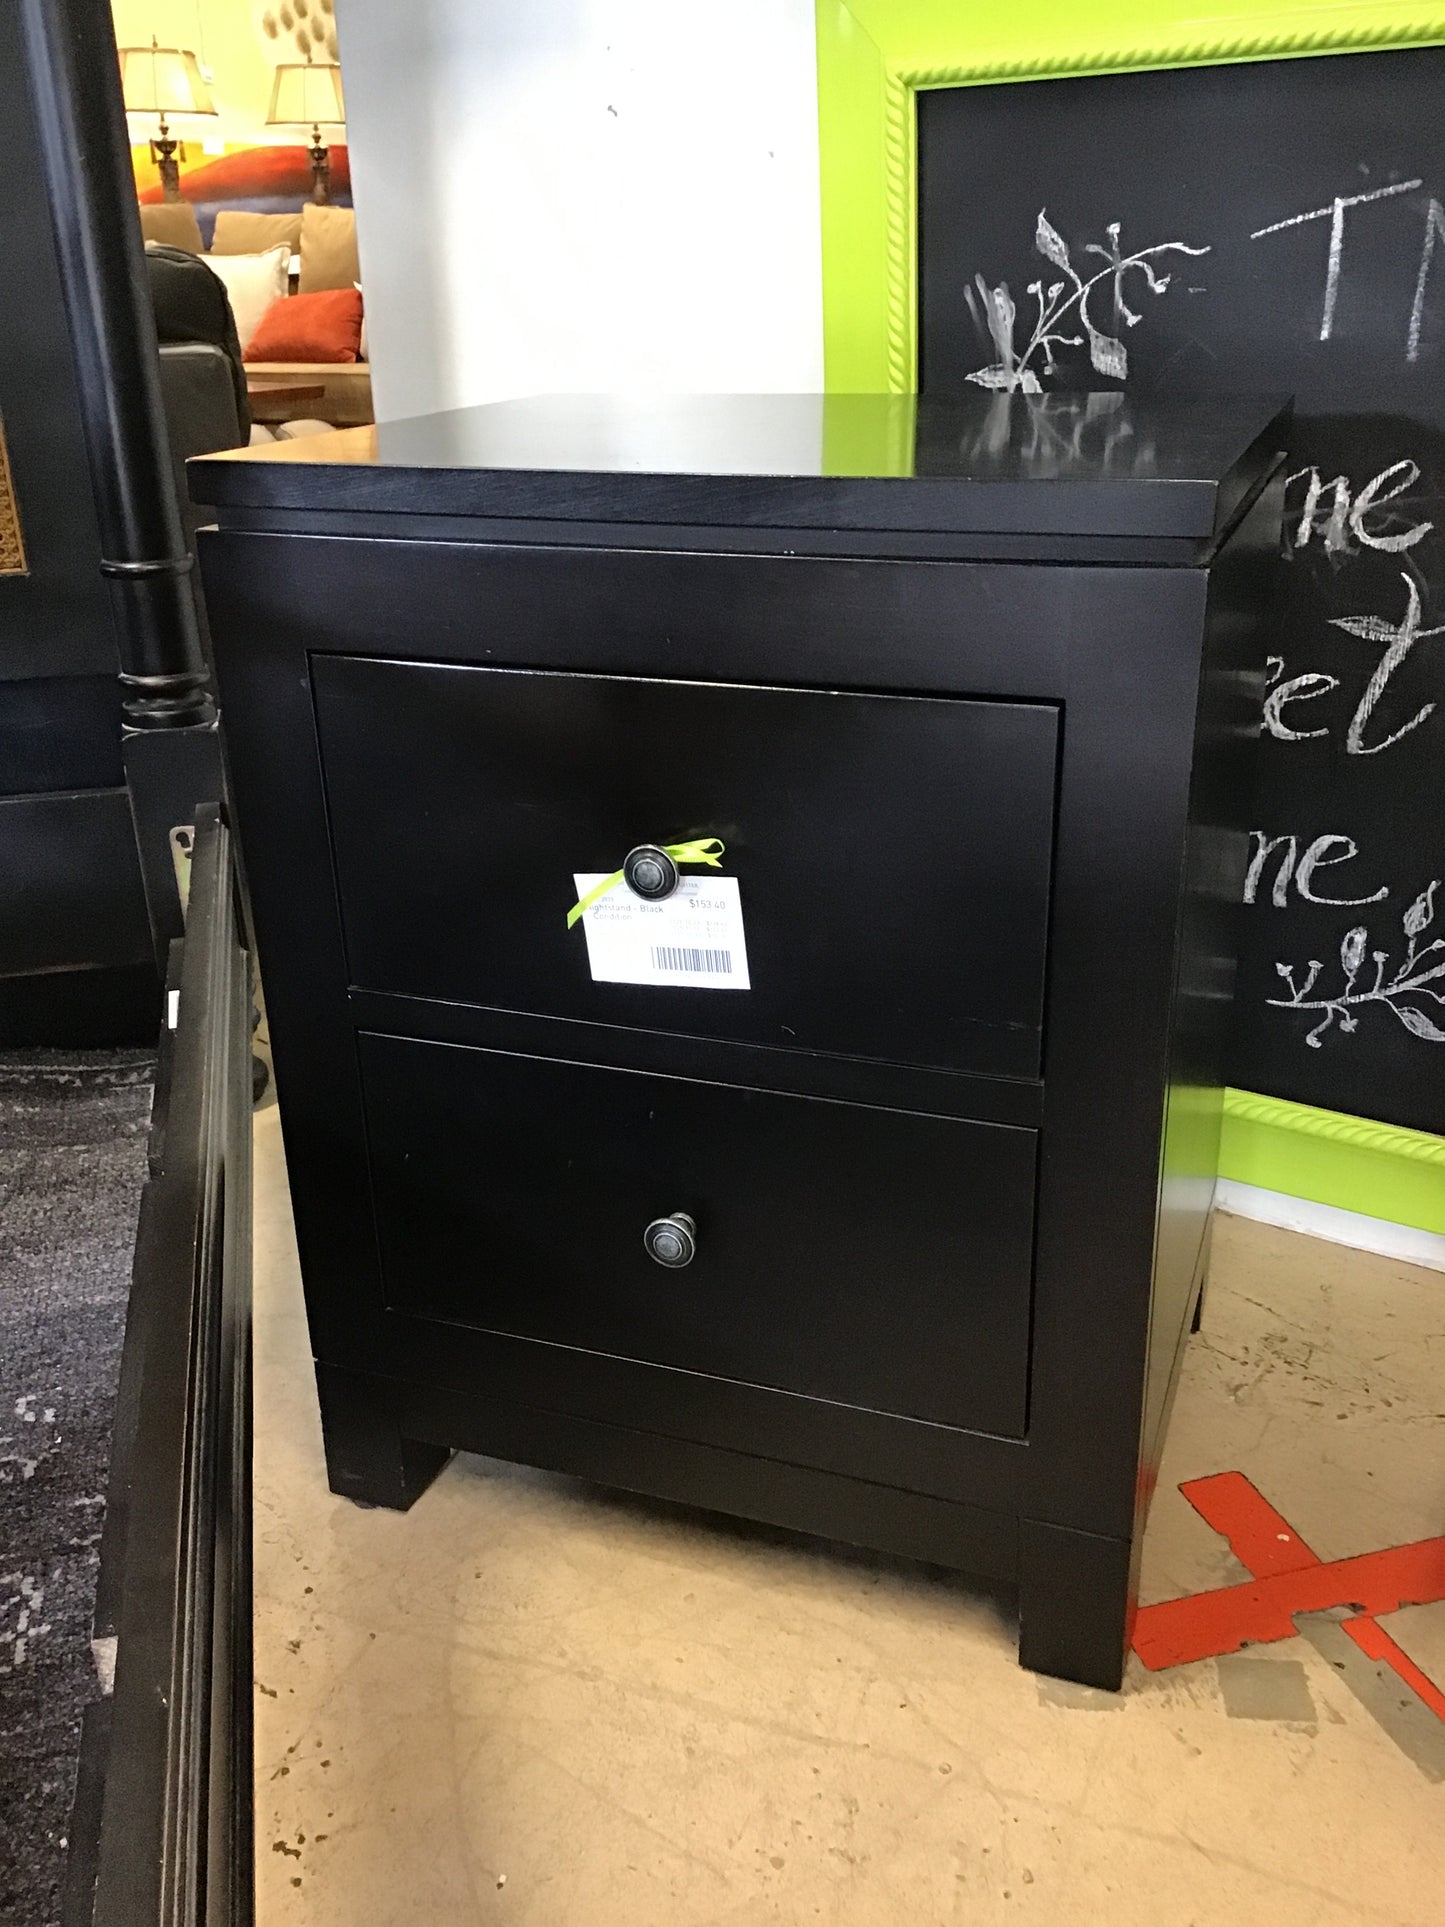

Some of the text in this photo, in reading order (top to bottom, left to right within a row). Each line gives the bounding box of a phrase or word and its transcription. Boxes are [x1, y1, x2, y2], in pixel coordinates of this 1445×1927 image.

[1260, 571, 1445, 755] et
[640, 904, 664, 913] Black
[688, 898, 726, 910] $15340
